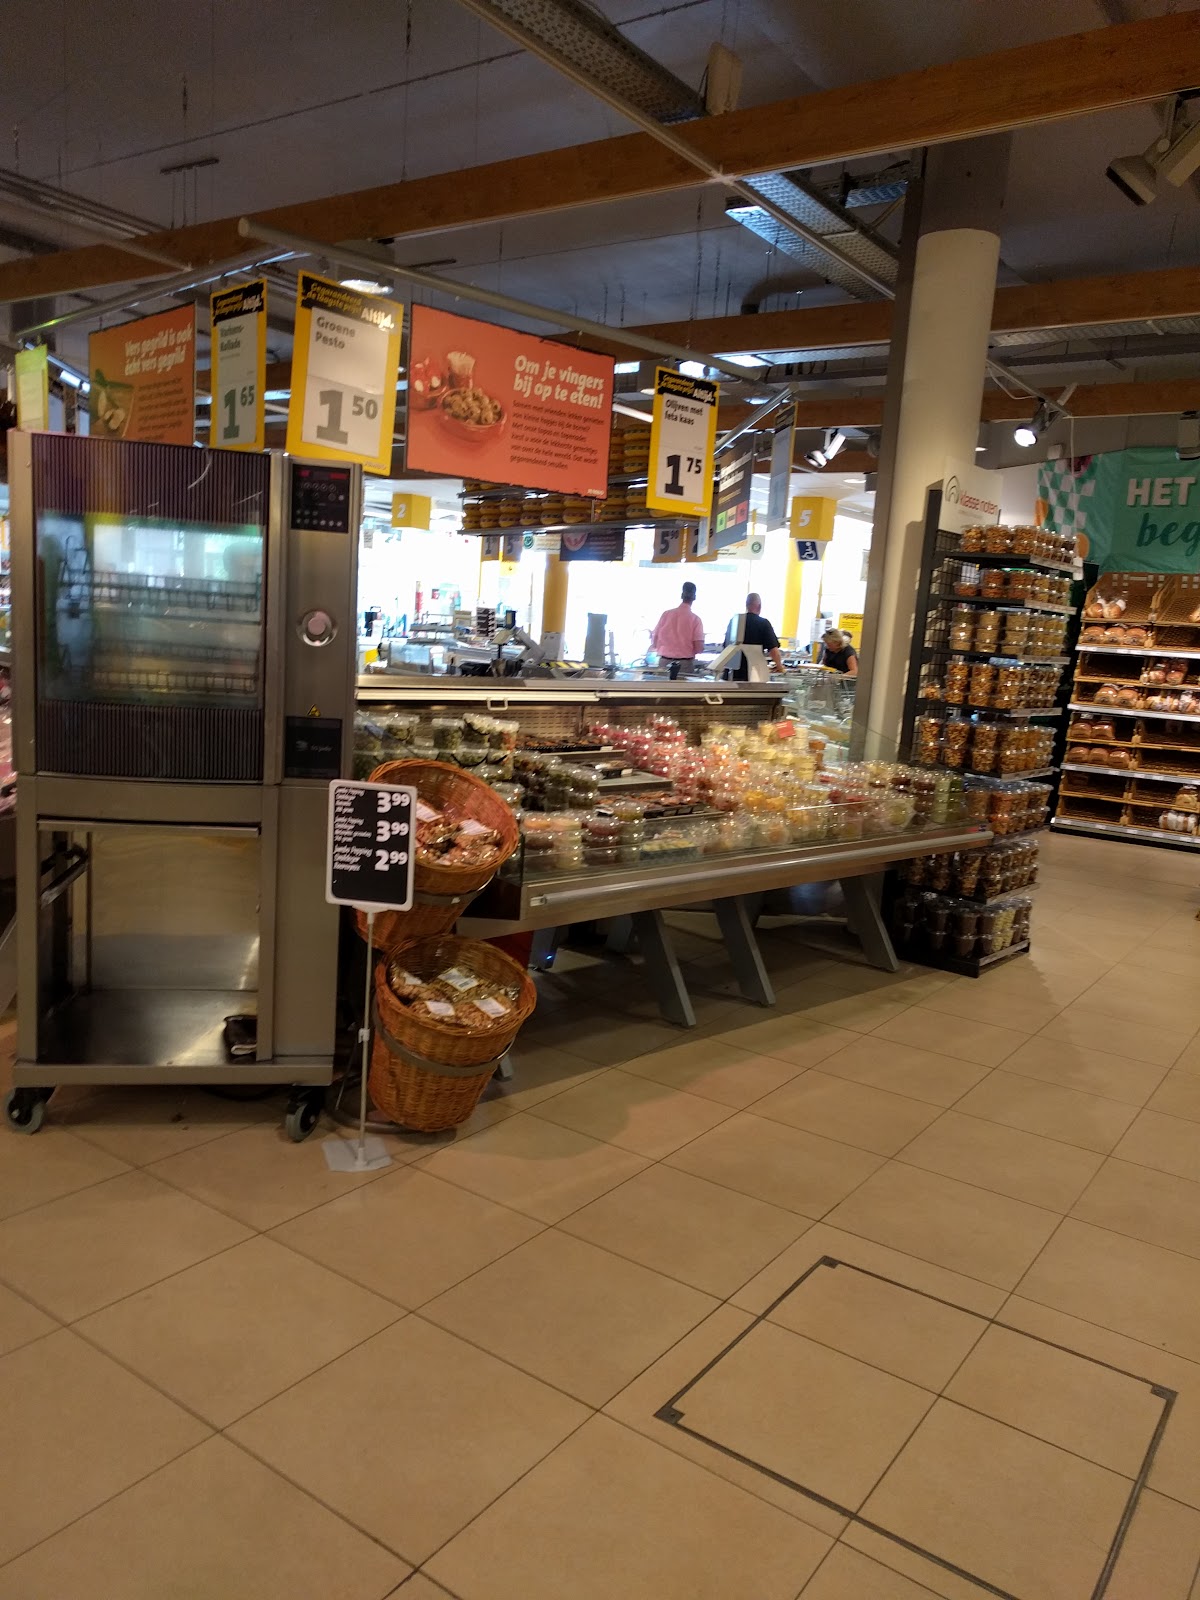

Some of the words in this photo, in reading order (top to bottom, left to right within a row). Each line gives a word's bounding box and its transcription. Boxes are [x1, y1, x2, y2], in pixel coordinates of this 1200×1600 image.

[315, 331, 346, 349] Pesto
[316, 316, 356, 338] Groene
[514, 355, 540, 375] Om
[541, 360, 557, 382] je
[558, 365, 605, 391] vingers
[513, 373, 533, 398] bij
[533, 383, 553, 402] op
[554, 383, 568, 402] te
[569, 389, 604, 409] eten!
[223, 388, 240, 440] 1
[240, 384, 255, 408] 65
[316, 389, 348, 445] 1
[351, 394, 379, 420] 50
[664, 410, 678, 422] feta
[679, 413, 695, 426] kaas
[665, 399, 689, 413] Olijven
[689, 406, 703, 416] met
[664, 454, 684, 496] 1
[686, 456, 702, 474] 75
[960, 489, 980, 511] klasse
[980, 500, 998, 516] noten
[1126, 476, 1196, 506] HET
[396, 503, 407, 519] 2
[798, 509, 813, 527] 5
[659, 530, 670, 555] 5
[1136, 512, 1200, 557] beg
